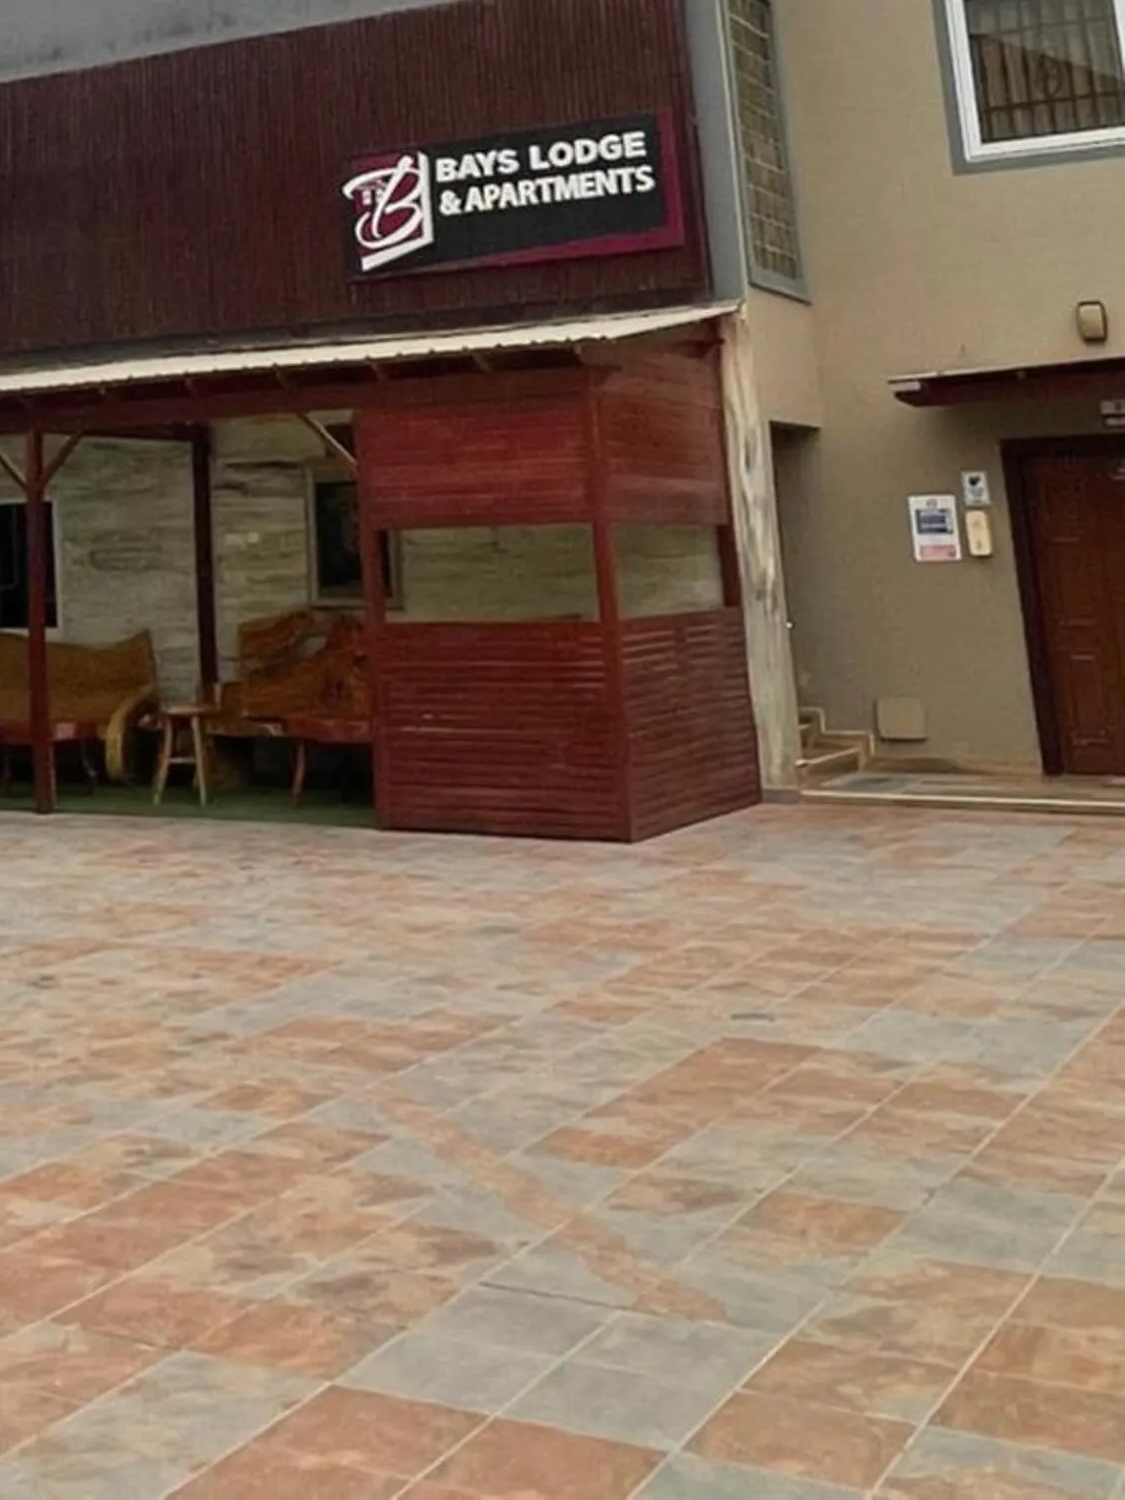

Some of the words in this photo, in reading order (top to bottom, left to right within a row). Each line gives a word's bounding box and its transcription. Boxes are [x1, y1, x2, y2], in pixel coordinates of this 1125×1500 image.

[435, 149, 520, 183] BAYS
[529, 130, 647, 171] LODGE
[439, 188, 463, 216] &
[464, 165, 656, 213] APARTMENTS
